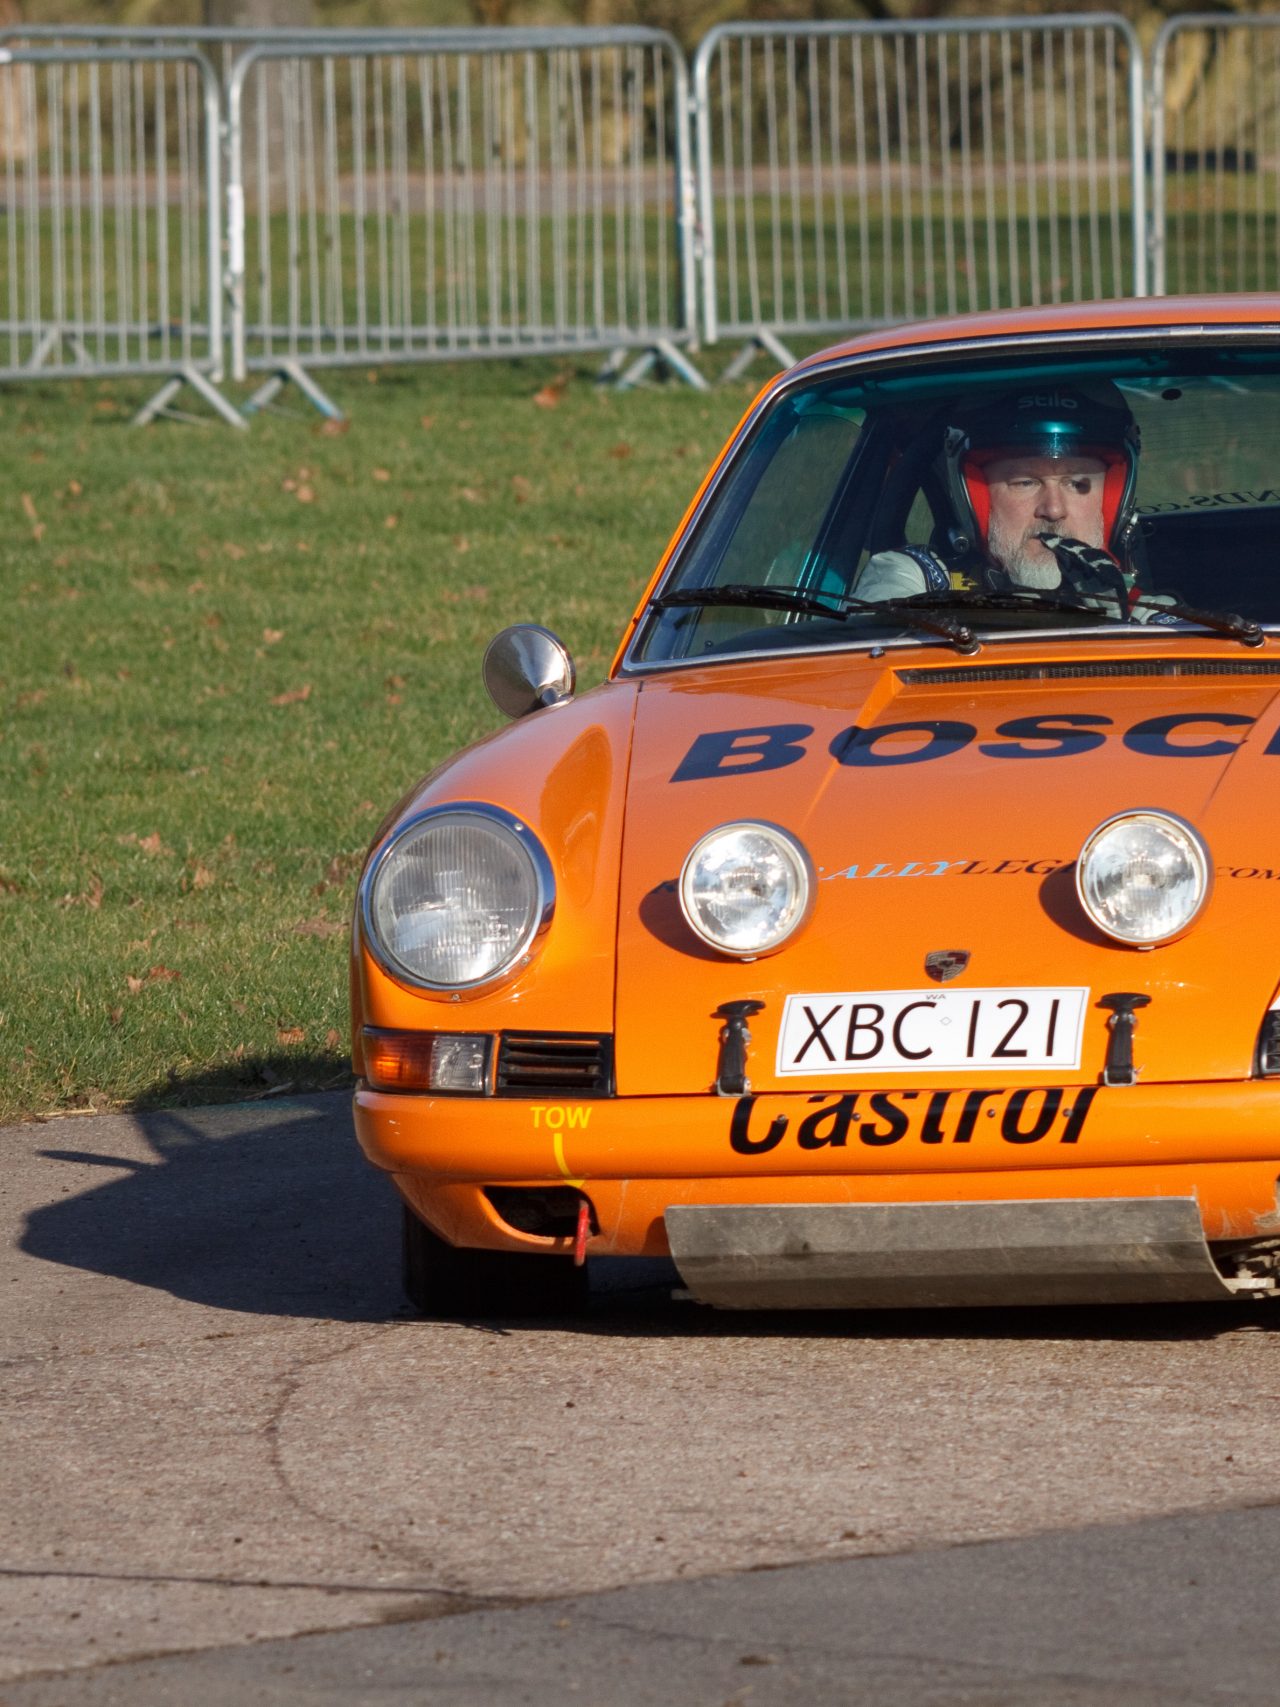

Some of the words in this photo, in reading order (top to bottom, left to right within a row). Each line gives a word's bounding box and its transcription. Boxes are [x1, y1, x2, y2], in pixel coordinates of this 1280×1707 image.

[793, 1000, 937, 1063] XBC
[966, 999, 1060, 1059] 121
[530, 1106, 593, 1129] TOW
